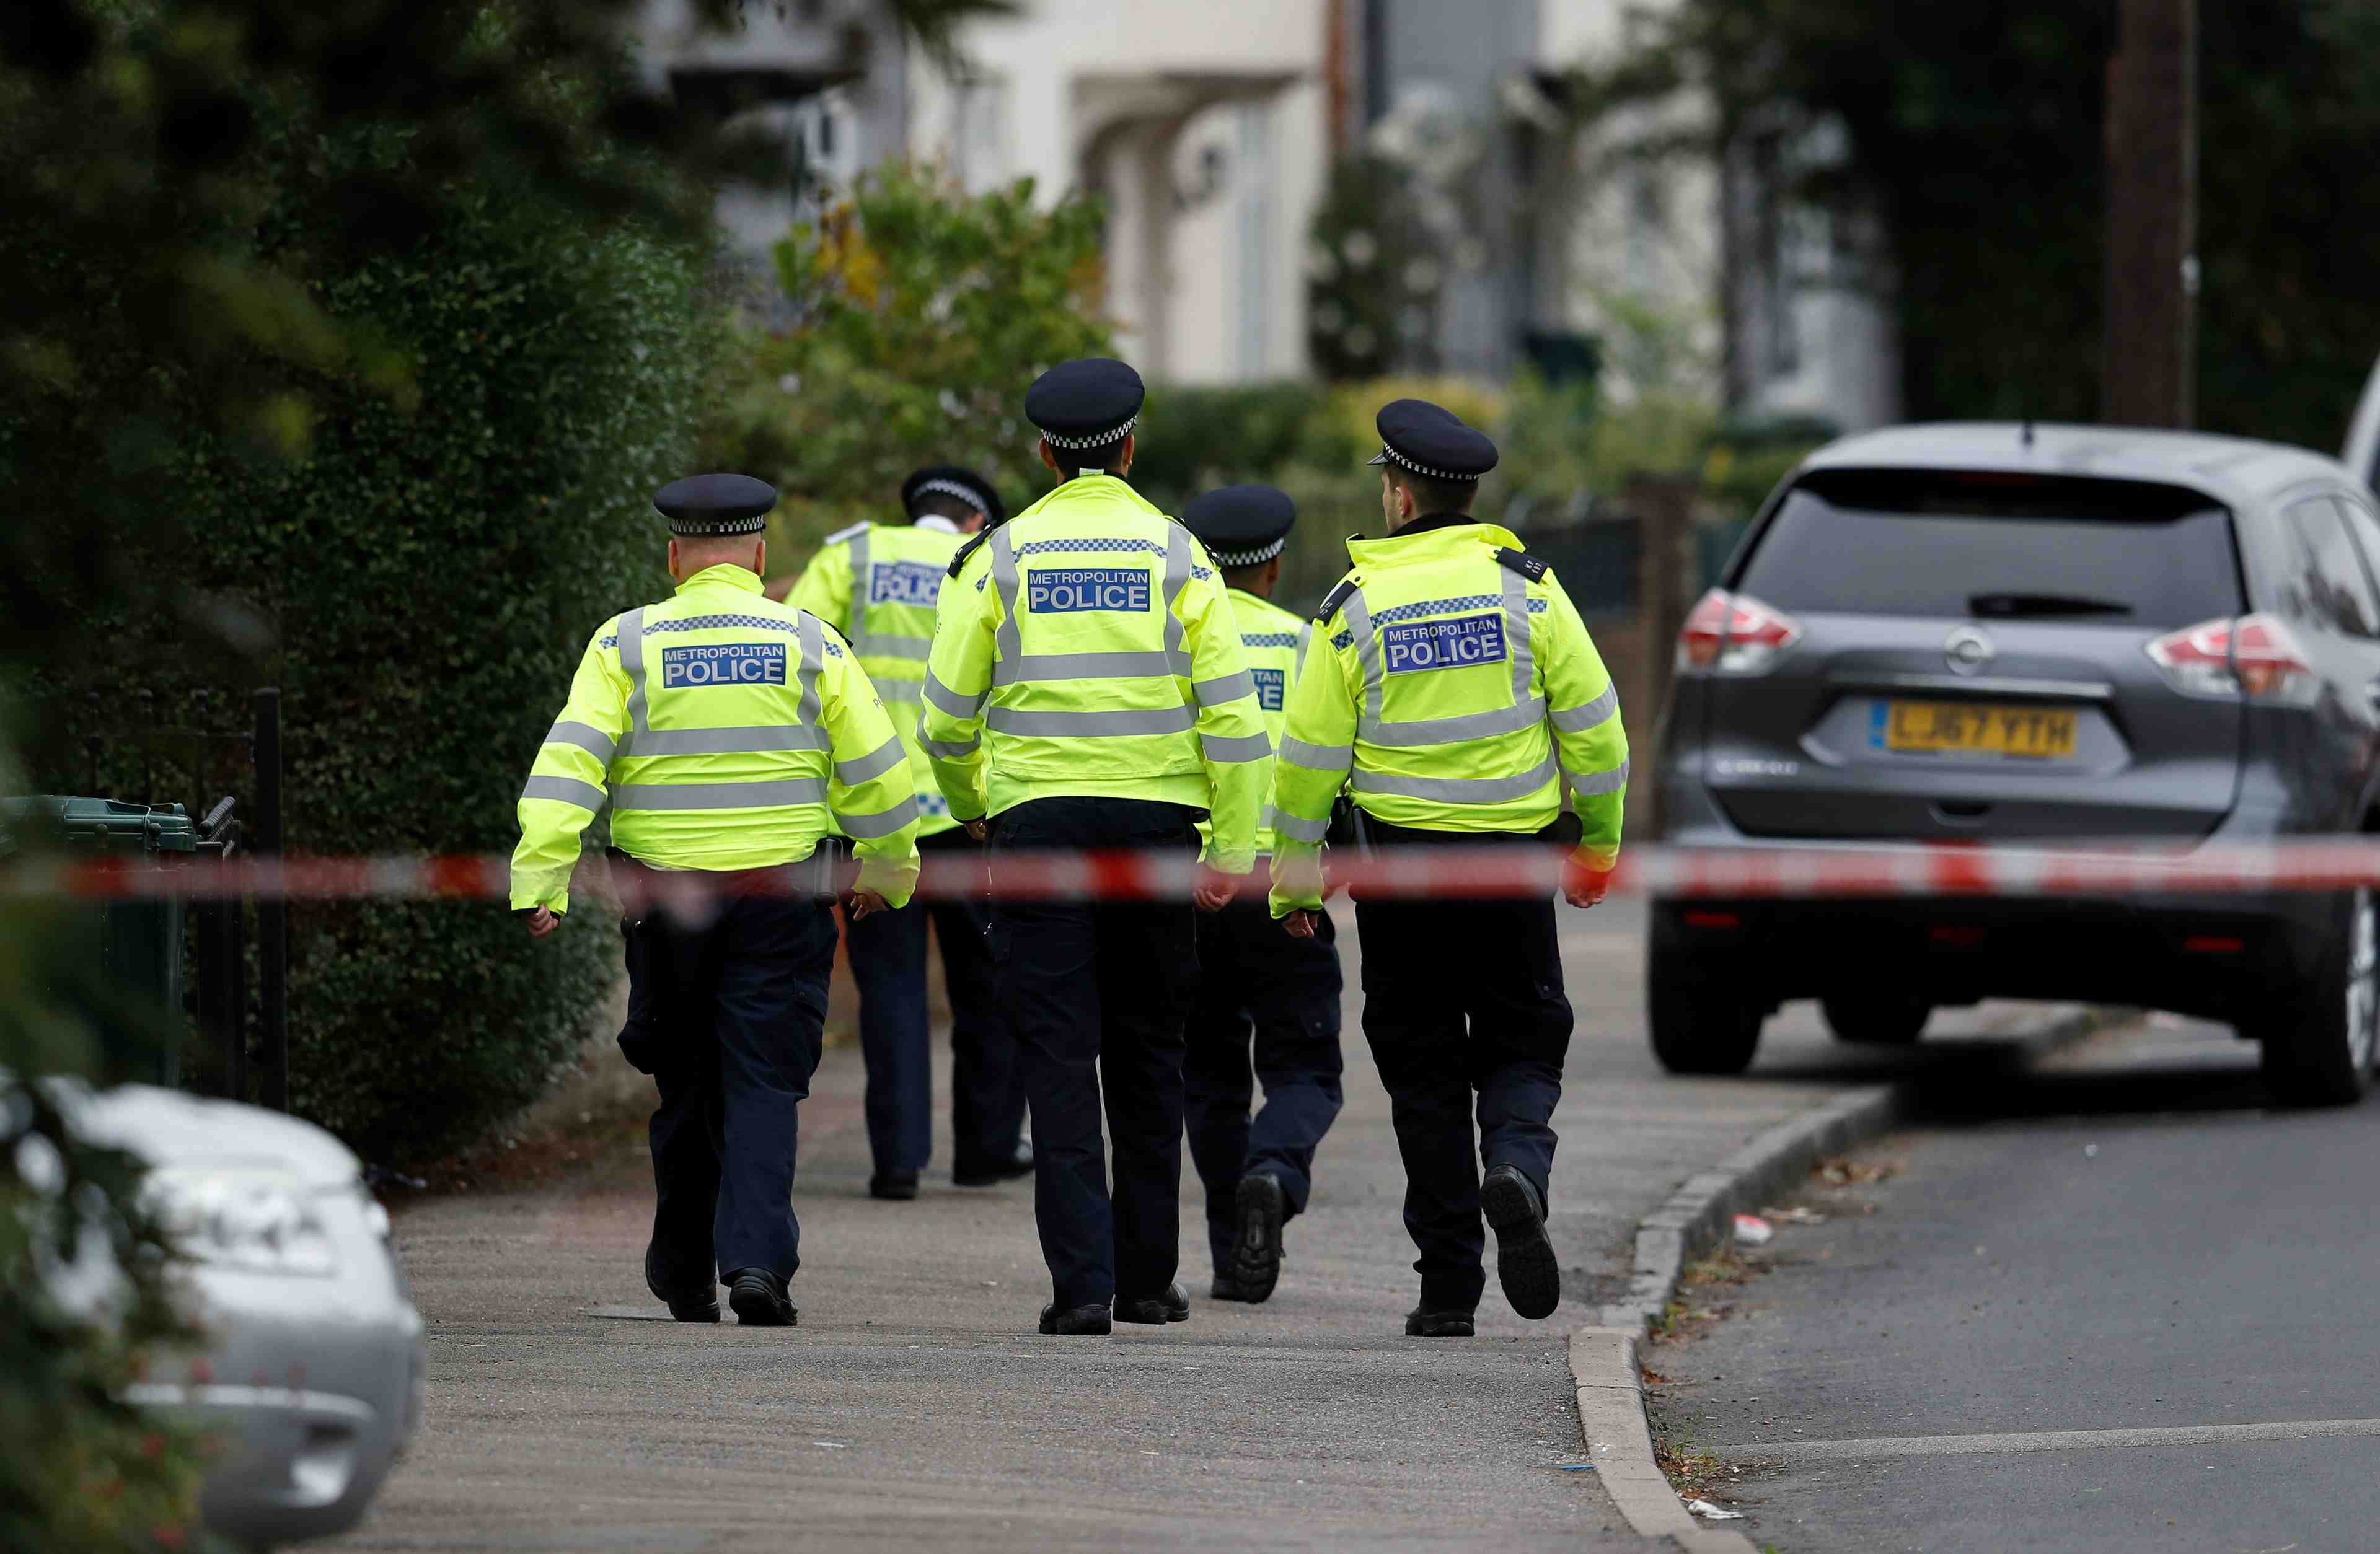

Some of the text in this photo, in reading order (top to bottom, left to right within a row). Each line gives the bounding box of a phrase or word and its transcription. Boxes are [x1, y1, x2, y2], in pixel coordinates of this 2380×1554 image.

[875, 574, 940, 602] POLIC
[1029, 571, 1148, 584] METROPOLITAN
[1029, 585, 1148, 610] POLICE
[1388, 619, 1497, 642] METROPOLITAN
[664, 646, 783, 662] METROPOLITAN
[1388, 633, 1501, 668] POLICE
[664, 659, 783, 685] POLICE
[1893, 703, 2073, 748] LJ67 YTH
